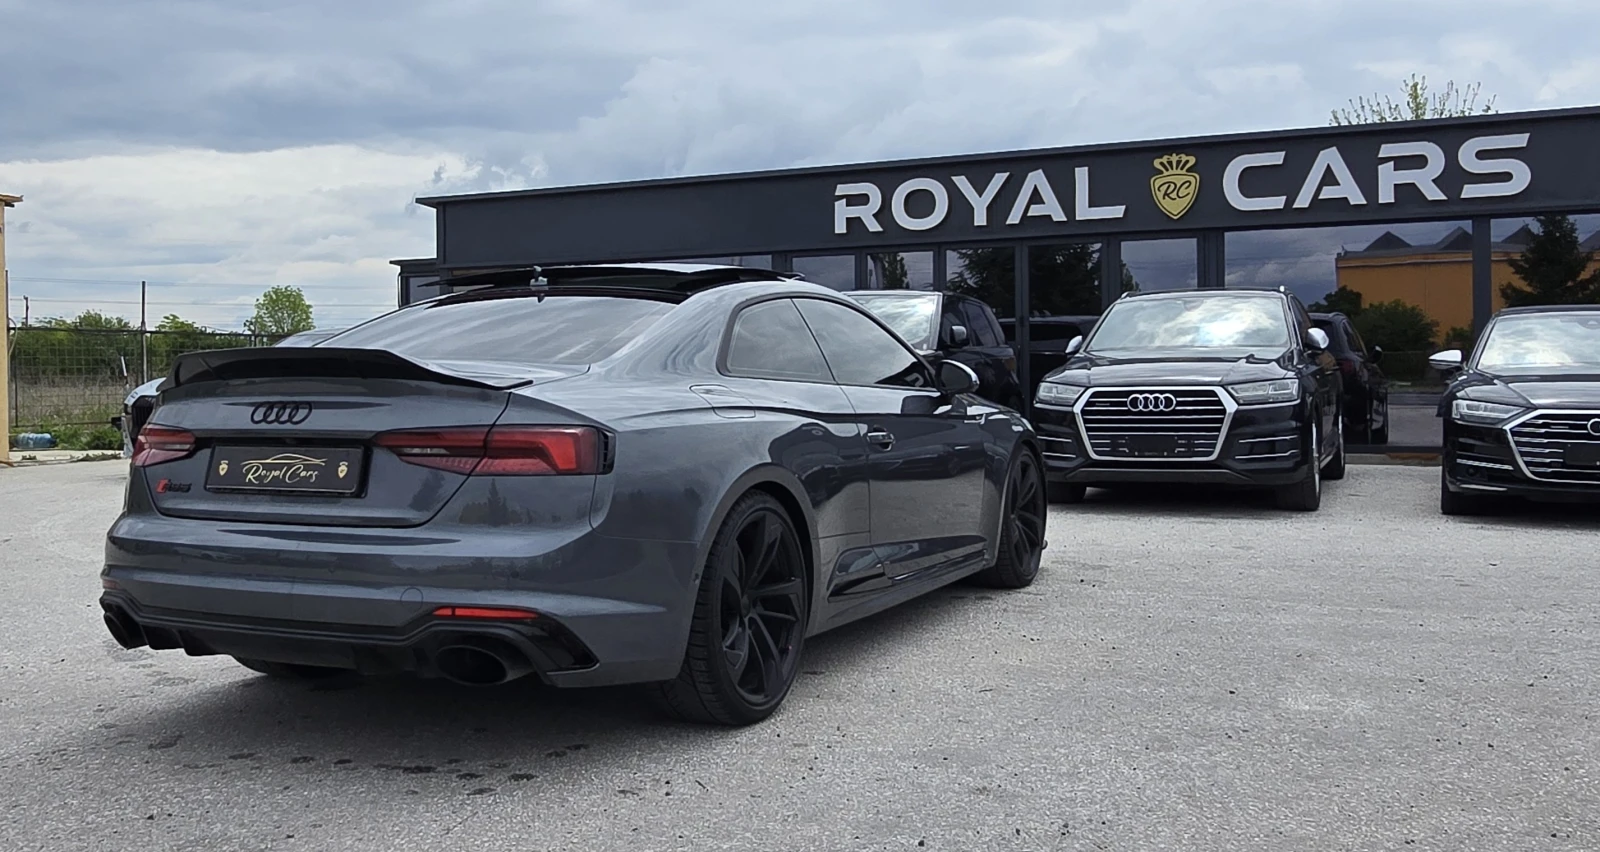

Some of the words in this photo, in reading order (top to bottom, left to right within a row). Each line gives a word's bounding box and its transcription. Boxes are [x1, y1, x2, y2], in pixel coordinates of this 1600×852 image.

[834, 166, 1126, 234] ROYAL
[1222, 132, 1532, 211] CARS
[1157, 180, 1192, 201] RC
[243, 463, 287, 484] Royal
[286, 464, 318, 483] Cars
